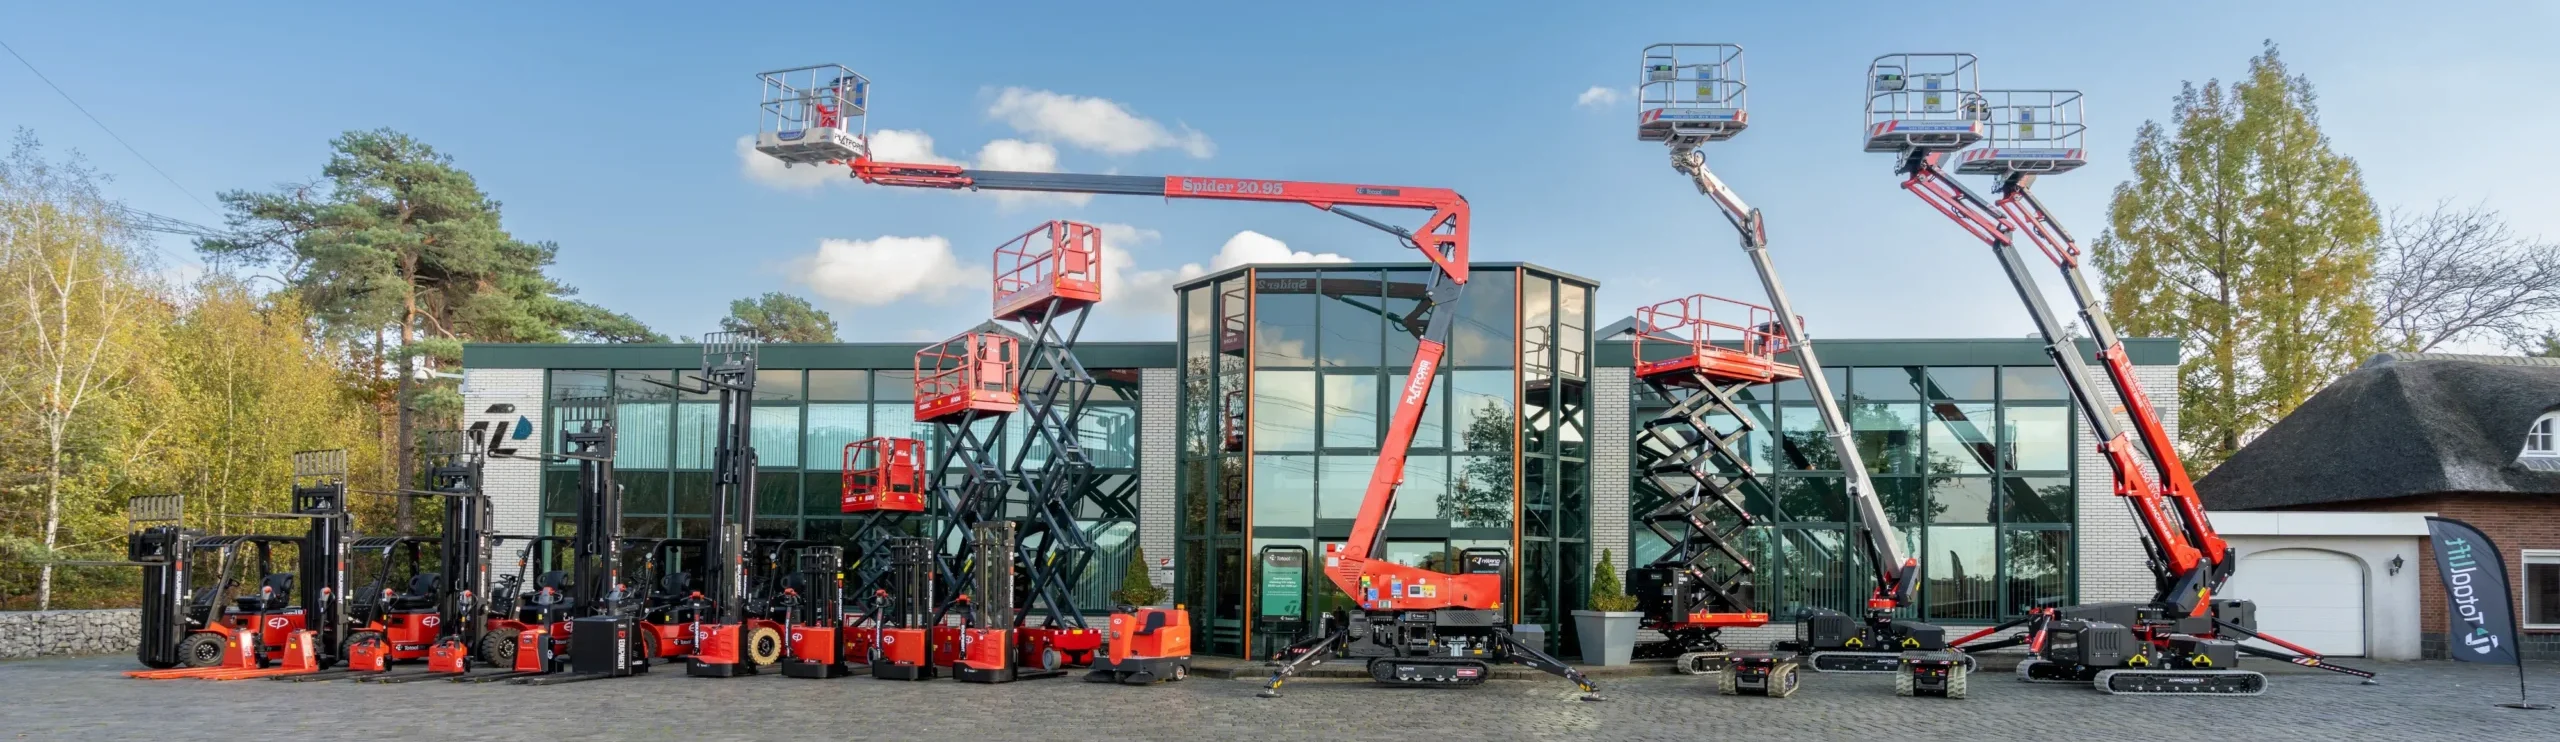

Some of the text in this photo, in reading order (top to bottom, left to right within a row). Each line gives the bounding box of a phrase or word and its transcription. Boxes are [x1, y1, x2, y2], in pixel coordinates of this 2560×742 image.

[1182, 178, 1283, 195] Spider 20.95
[2138, 463, 2151, 483] 1250
[2147, 481, 2160, 500] EVO
[268, 617, 288, 629] EP
[422, 616, 440, 627] EP
